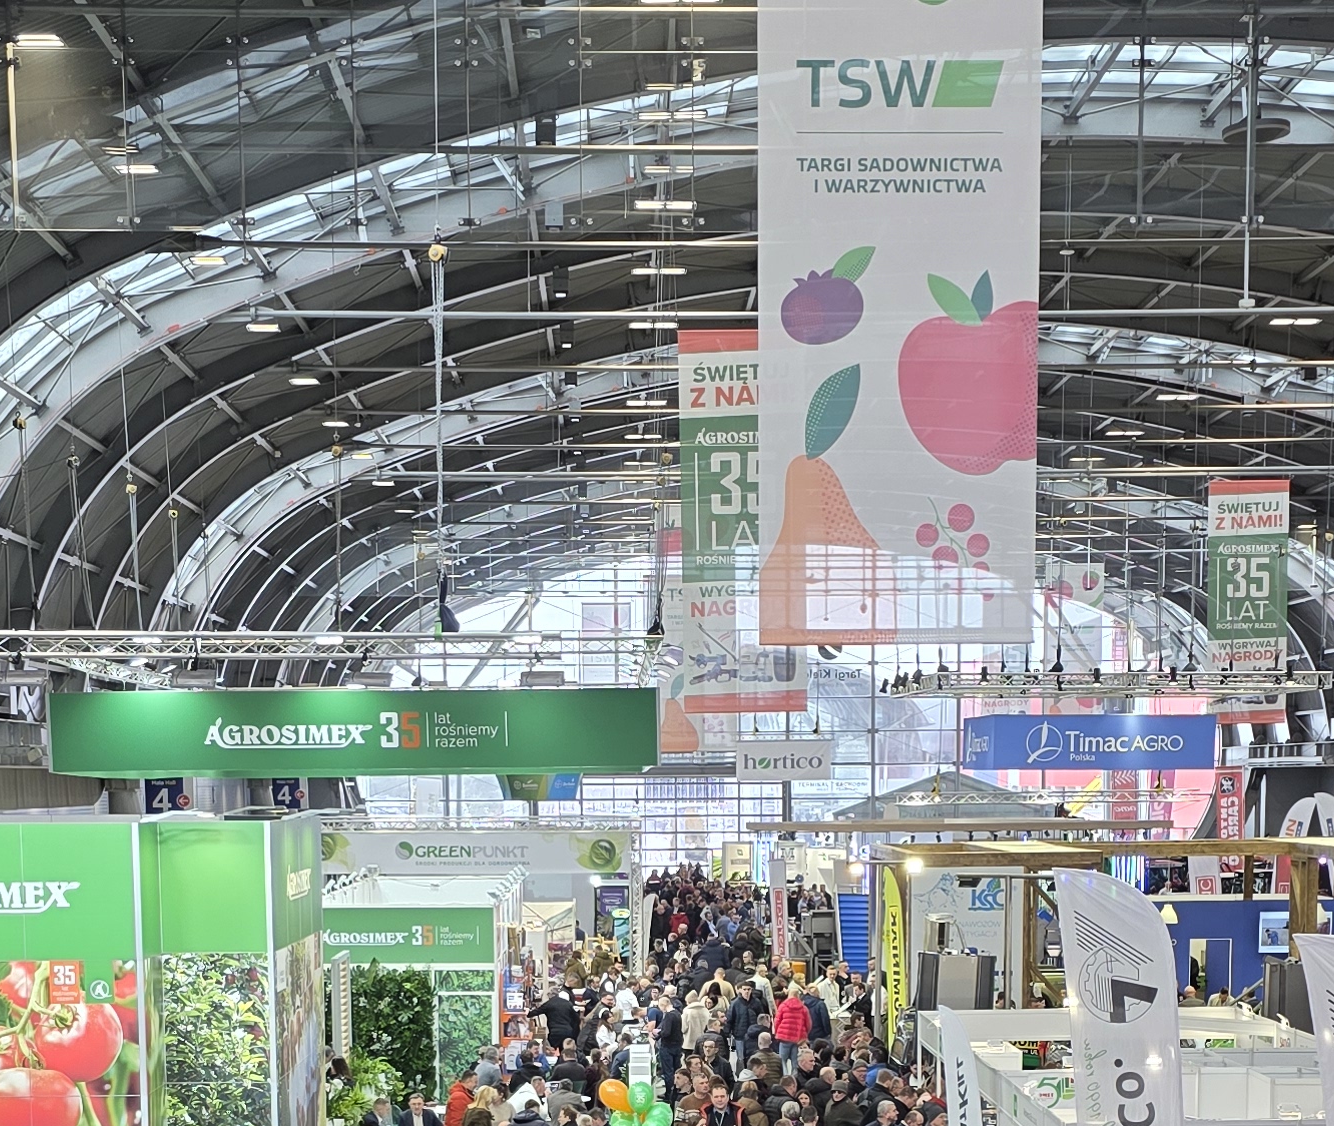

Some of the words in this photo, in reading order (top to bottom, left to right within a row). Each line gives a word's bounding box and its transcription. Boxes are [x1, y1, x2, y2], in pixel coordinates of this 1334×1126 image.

[796, 59, 936, 108] TSW
[796, 157, 851, 172] TARGI
[858, 157, 1002, 172] SADOWNICTWA
[814, 178, 818, 193] I
[825, 178, 986, 193] WARZYWNICTWA
[693, 363, 759, 386] ŚWIĘT
[690, 387, 706, 408] Z
[1217, 500, 1280, 520] ŚWIĘTUJ
[1215, 516, 1226, 531] Z
[1231, 513, 1283, 529] NAMI!
[1217, 542, 1280, 555] AGROSIMEX
[1227, 557, 1270, 598] 35
[1227, 601, 1269, 620] LAT
[1218, 638, 1277, 650] WYGRYWAJ
[1212, 650, 1282, 663] NAGRODY
[434, 711, 451, 724] lat
[204, 717, 373, 749] AGROSIMEX
[379, 711, 421, 748] 35
[434, 724, 499, 737] rośniemy
[434, 737, 478, 748] razem
[744, 753, 823, 769] hortico
[1070, 753, 1095, 761] Polska
[152, 788, 172, 812] 4
[277, 785, 292, 804] 4
[415, 845, 529, 858] GREENPUNKT
[970, 889, 1005, 911] KSC
[412, 925, 433, 945] 35
[440, 932, 474, 941] rośniemy
[53, 965, 76, 985] 35
